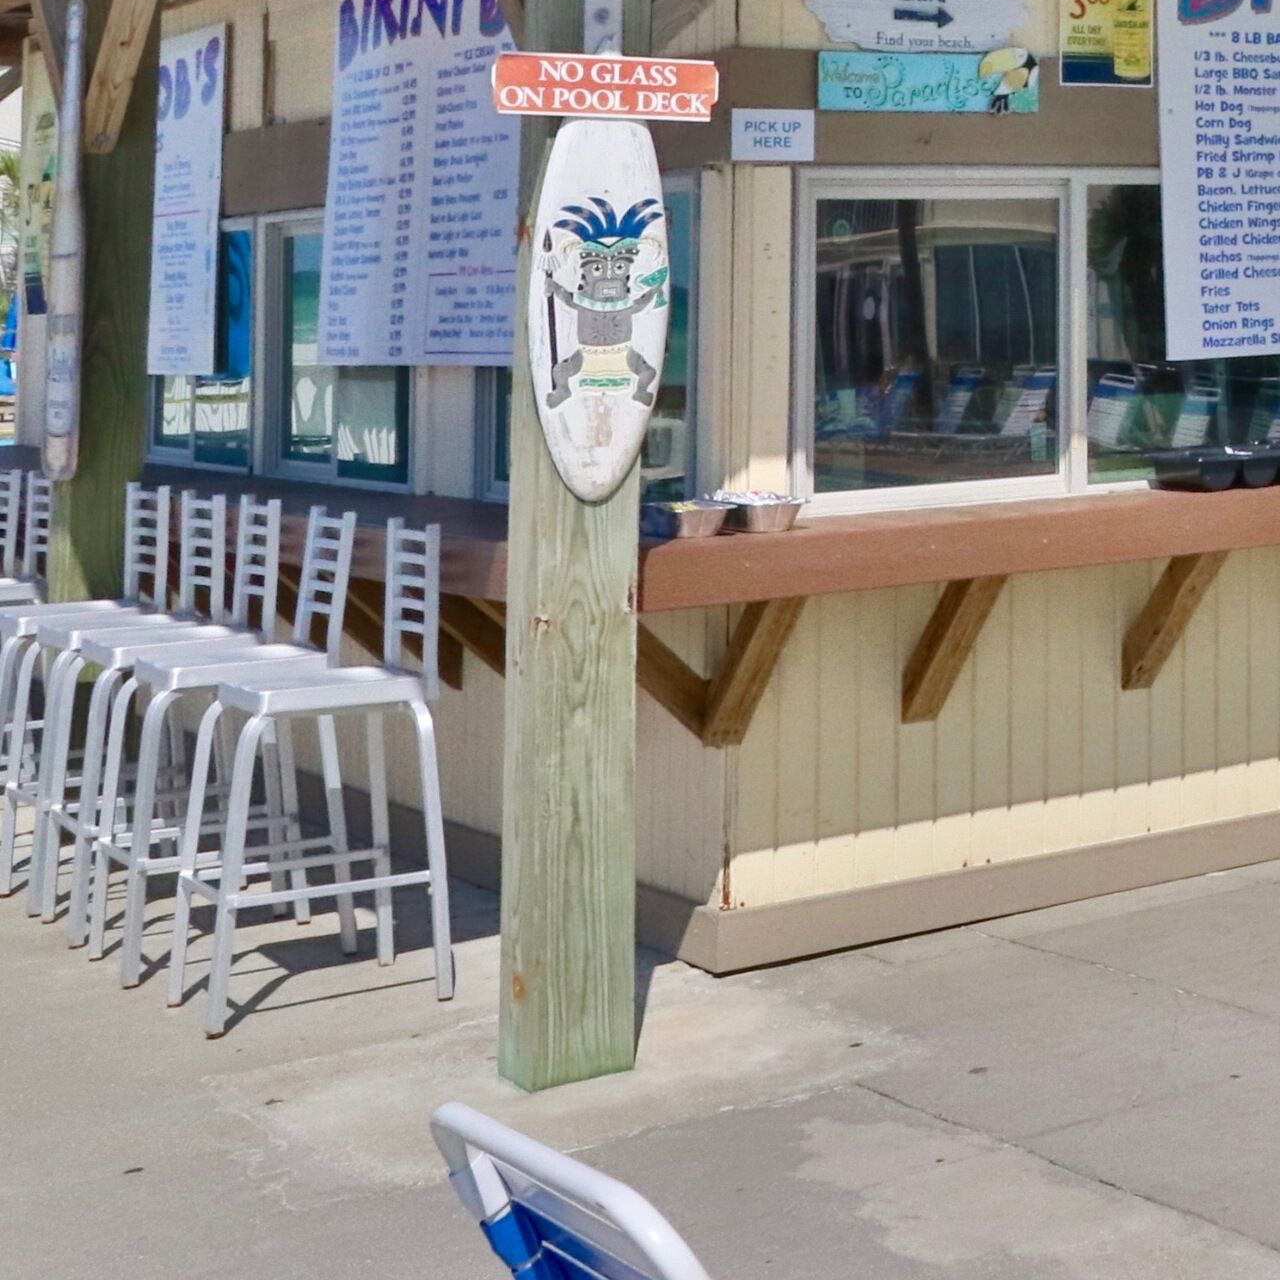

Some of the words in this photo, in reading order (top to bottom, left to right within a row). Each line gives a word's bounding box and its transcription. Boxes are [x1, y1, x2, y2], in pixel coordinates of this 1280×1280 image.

[876, 32, 904, 46] Find
[906, 34, 934, 50] your
[938, 32, 976, 49] beach.
[1231, 31, 1240, 44] 8
[1245, 31, 1262, 45] LB
[1214, 51, 1229, 63] lb.
[157, 35, 221, 121] OB'S
[538, 60, 584, 83] NO
[590, 62, 677, 88] GLASS
[820, 60, 881, 85] Welcome
[1194, 67, 1229, 82] Large
[1232, 68, 1258, 81] BBQ
[844, 86, 863, 99] TO
[1214, 84, 1229, 96] lb.
[1233, 85, 1278, 97] Monster
[500, 86, 546, 110] ON
[551, 87, 630, 113] POOL
[636, 90, 712, 115] DECK
[1195, 100, 1217, 112] Hot
[1220, 101, 1243, 116] Dog
[744, 121, 777, 134] PICK
[782, 121, 802, 134] UP
[1195, 117, 1225, 129] Corn
[1228, 117, 1251, 132] Dog
[753, 136, 793, 149] HERE
[1196, 134, 1230, 148] Philly
[1196, 151, 1228, 163] Fried
[1232, 150, 1275, 164] Shrimp
[1197, 167, 1214, 179] PB
[1218, 167, 1227, 179] &
[1232, 167, 1241, 179] J
[1198, 200, 1243, 213] Chicken
[1198, 217, 1243, 230] Chicken
[1199, 234, 1237, 246] Grilled
[1200, 251, 1242, 263] Nachos
[1201, 268, 1239, 280] Grilled
[1201, 285, 1231, 297] Fries
[1202, 302, 1231, 314] Tater
[1236, 301, 1260, 313] Tots
[1202, 319, 1237, 331] Onion
[1242, 318, 1275, 333] Rings
[1202, 333, 1267, 348] Mozzarella
